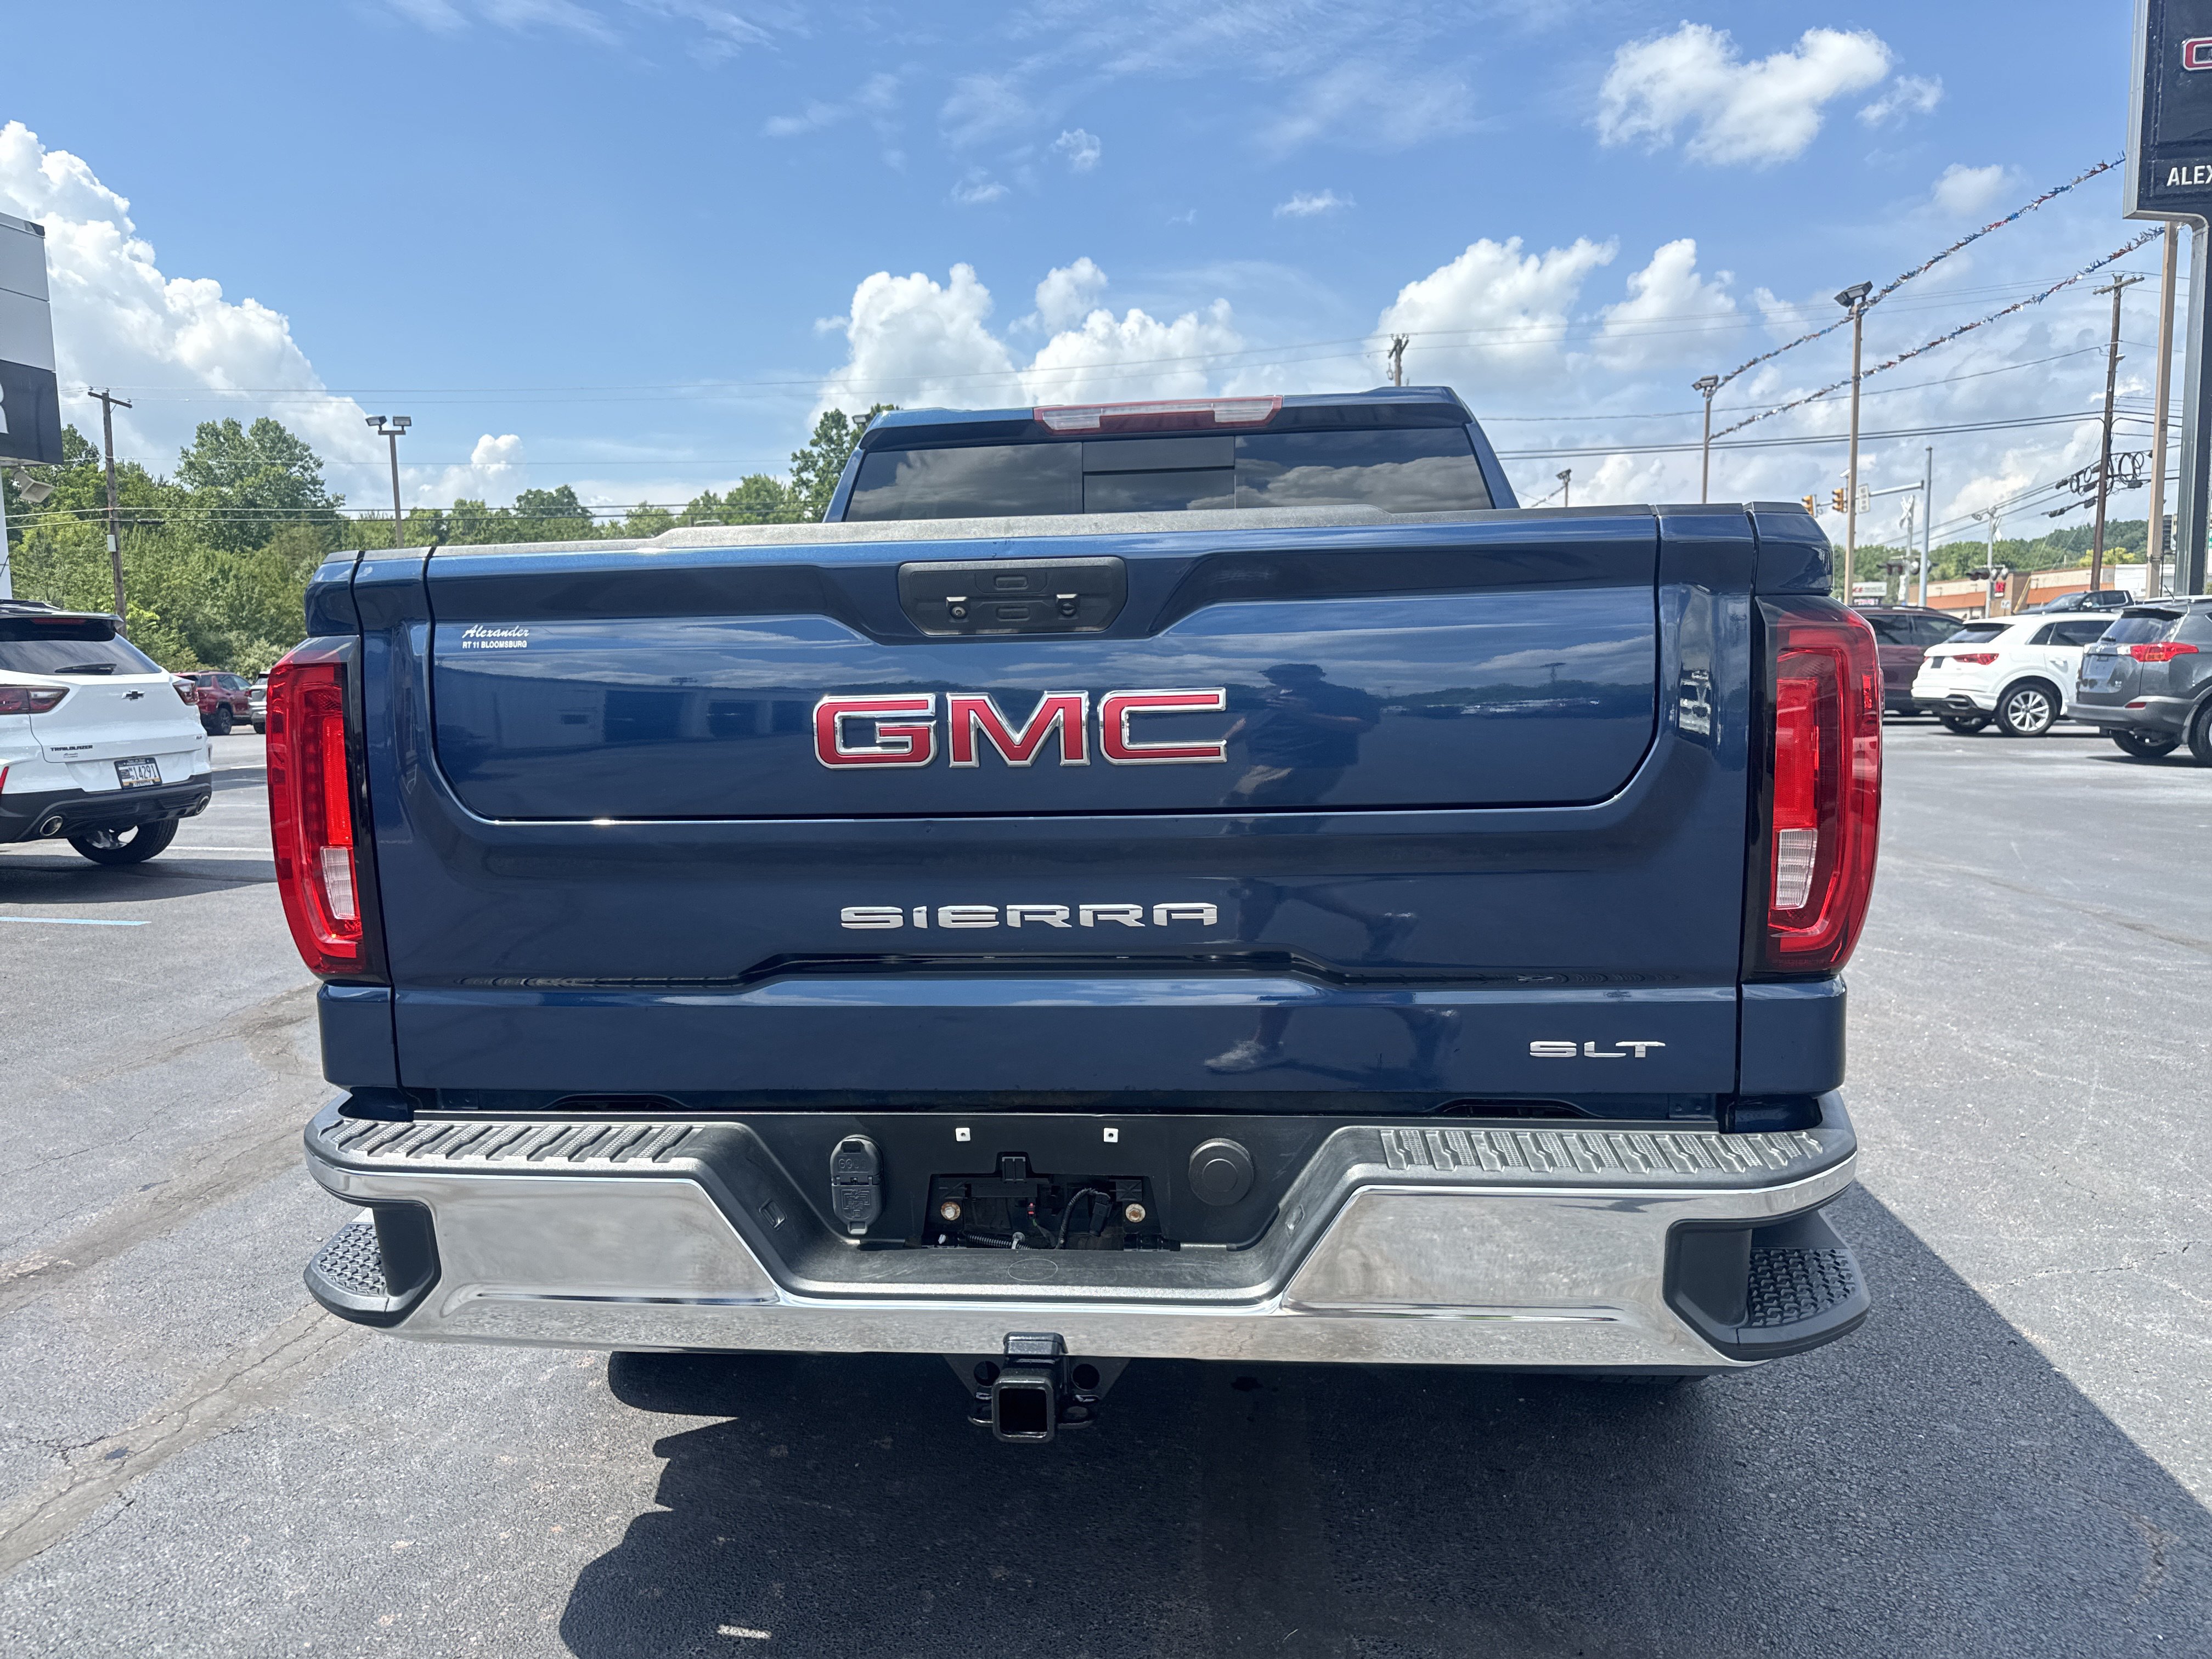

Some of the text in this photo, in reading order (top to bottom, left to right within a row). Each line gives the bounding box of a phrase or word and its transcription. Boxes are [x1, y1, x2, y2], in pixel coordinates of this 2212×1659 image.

[462, 624, 529, 638] Alexander
[481, 640, 527, 648] BLOOMSBURG
[813, 688, 1227, 768] GMC
[133, 765, 157, 780] 14291
[840, 902, 1217, 929] SIERRA
[1530, 1041, 1666, 1058] SLT
